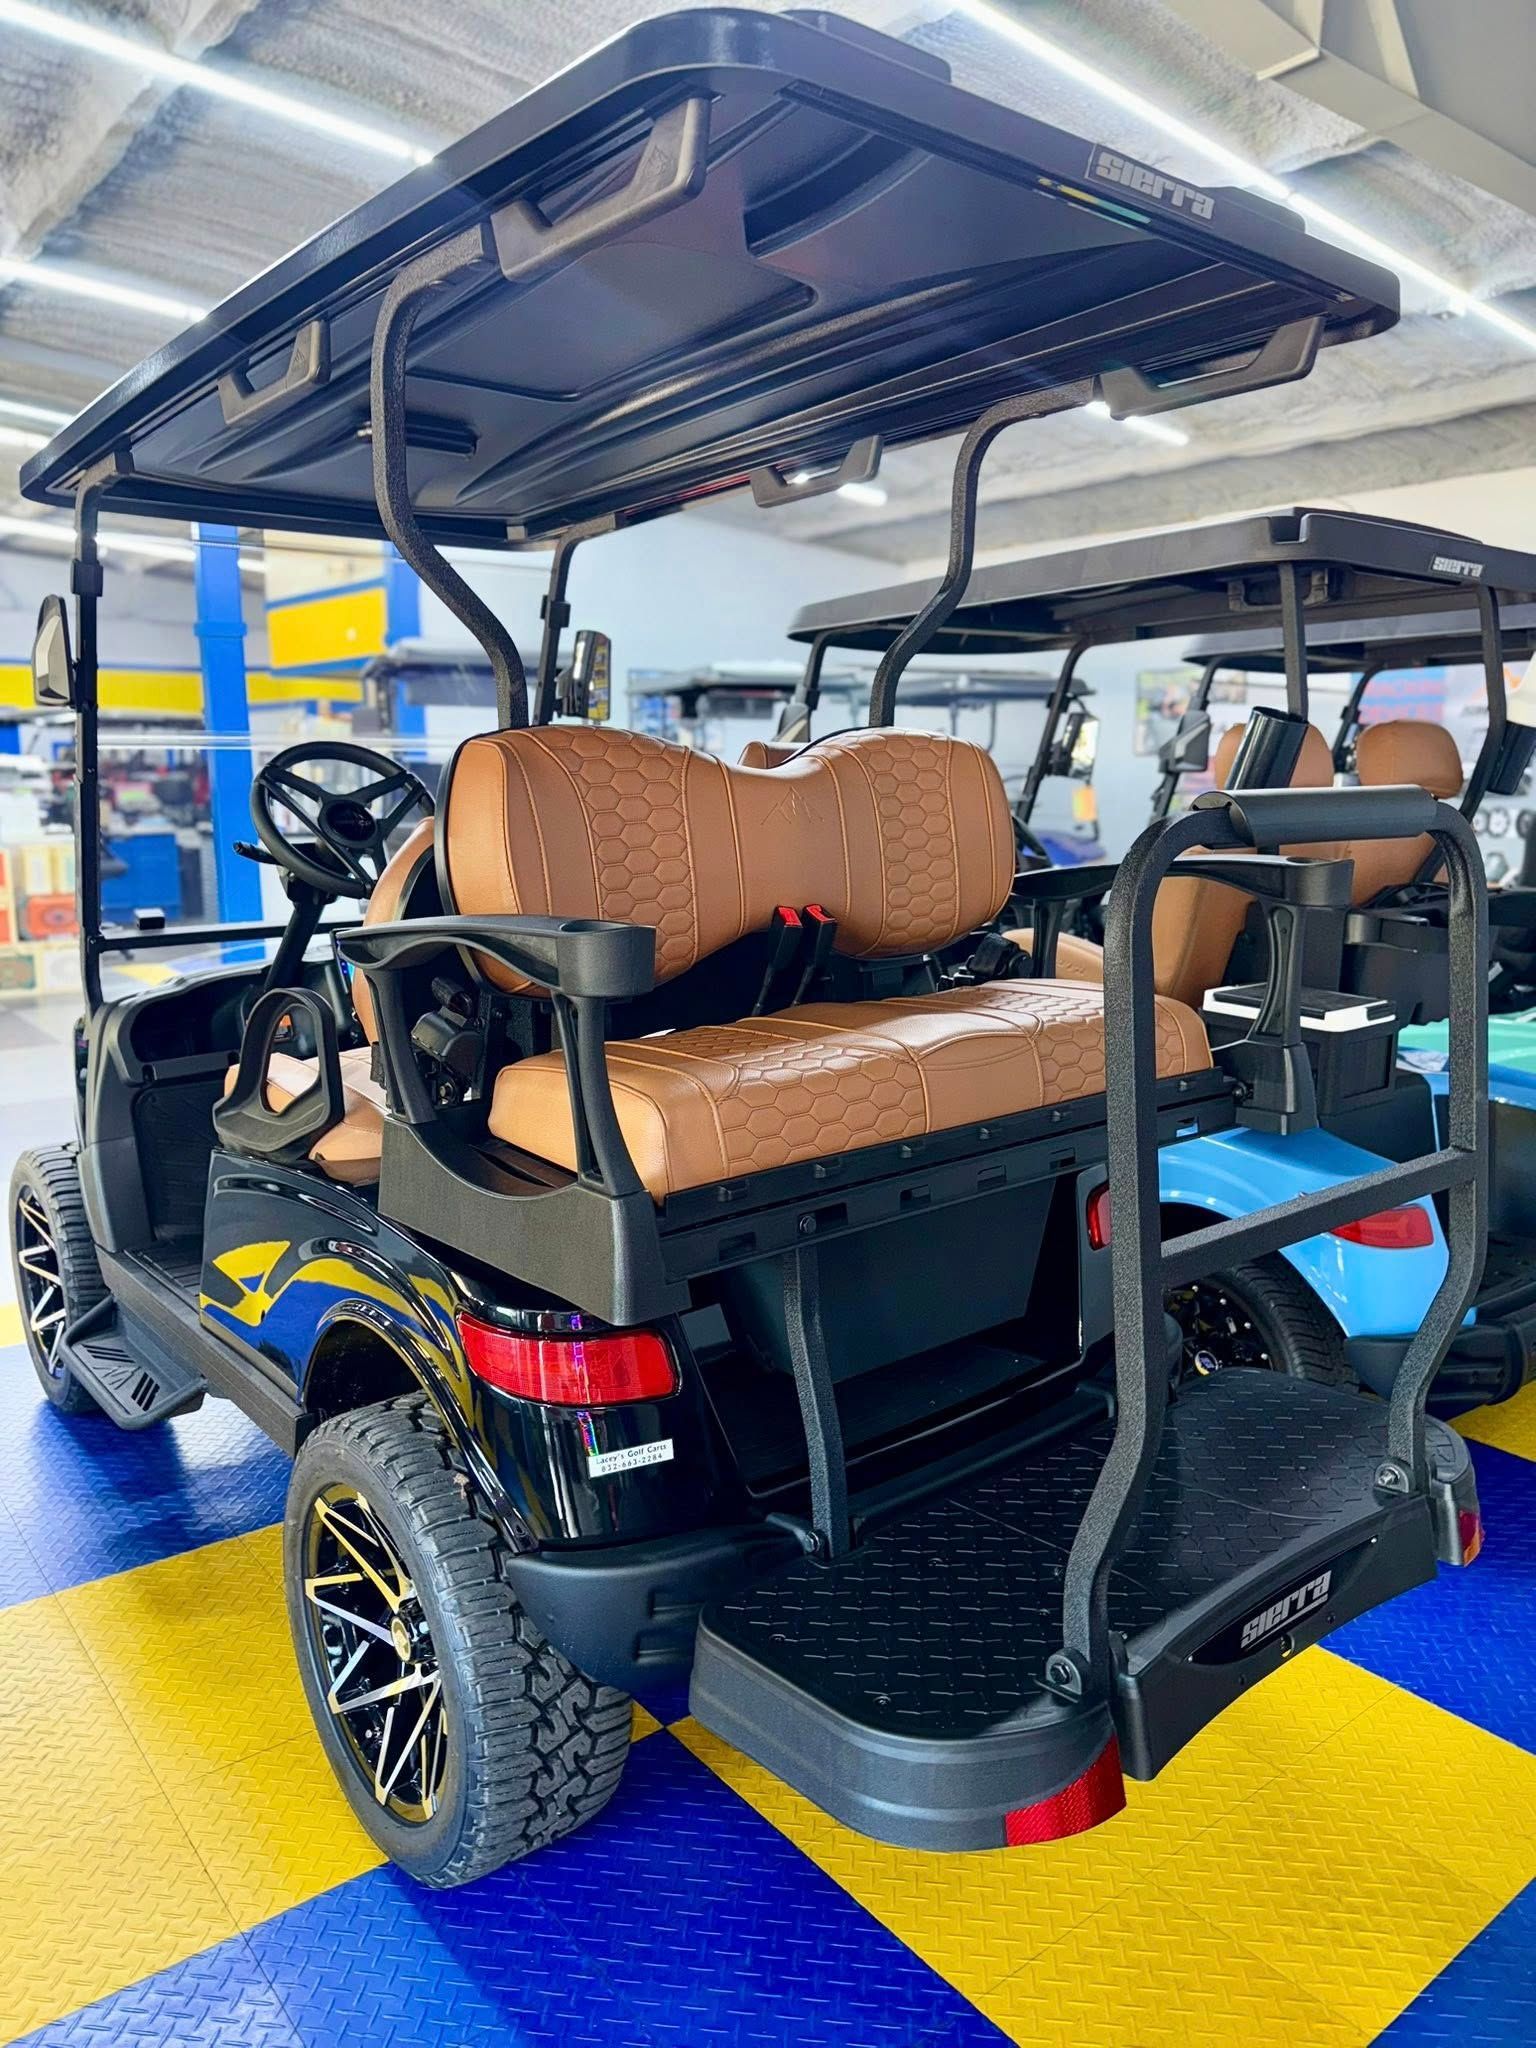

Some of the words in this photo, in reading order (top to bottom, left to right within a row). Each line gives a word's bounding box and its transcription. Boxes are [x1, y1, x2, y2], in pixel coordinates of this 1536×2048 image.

[596, 1453, 624, 1465] Lacey's
[627, 1448, 644, 1458] Golf
[647, 1444, 667, 1454] Carts
[601, 1453, 663, 1473] 832-663-2284
